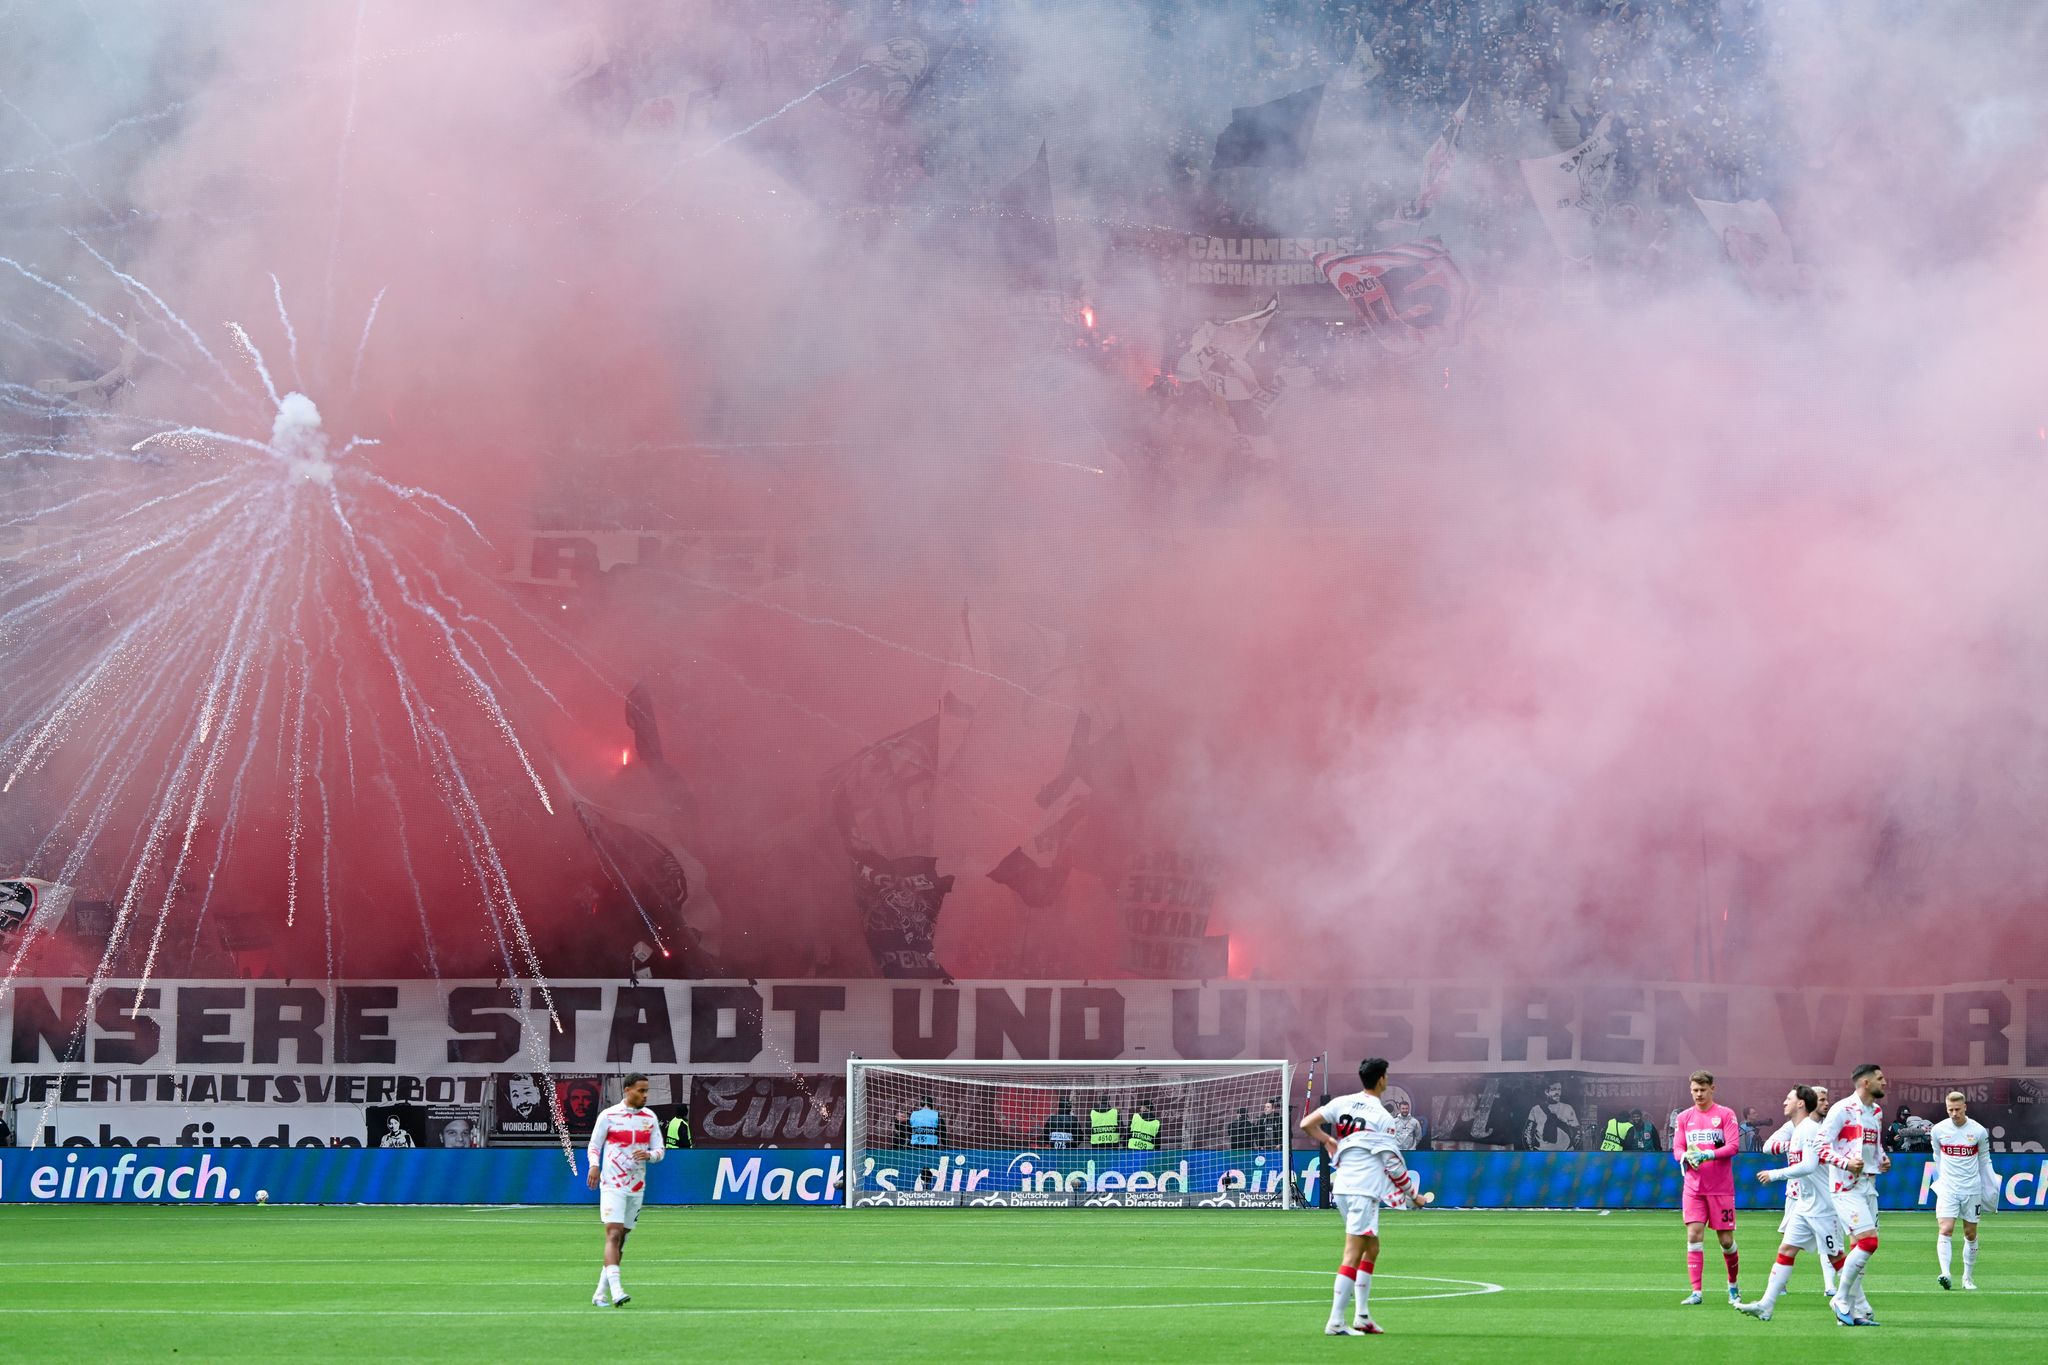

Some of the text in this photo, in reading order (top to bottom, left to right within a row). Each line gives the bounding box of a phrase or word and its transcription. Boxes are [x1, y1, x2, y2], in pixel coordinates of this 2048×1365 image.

[1188, 236, 1357, 260] CALIMEROS
[1345, 277, 1382, 297] BLOCK
[447, 986, 846, 1063] STADT
[892, 986, 1125, 1060] UND
[1172, 986, 1728, 1066] UNSEREN
[502, 1122, 547, 1132] WONDERLAND
[30, 1153, 241, 1199] einfach.
[1019, 1159, 1188, 1193] indeed
[898, 1191, 936, 1199] Deutsche
[1011, 1191, 1049, 1199] Deutsche
[1826, 1235, 1834, 1249] 6
